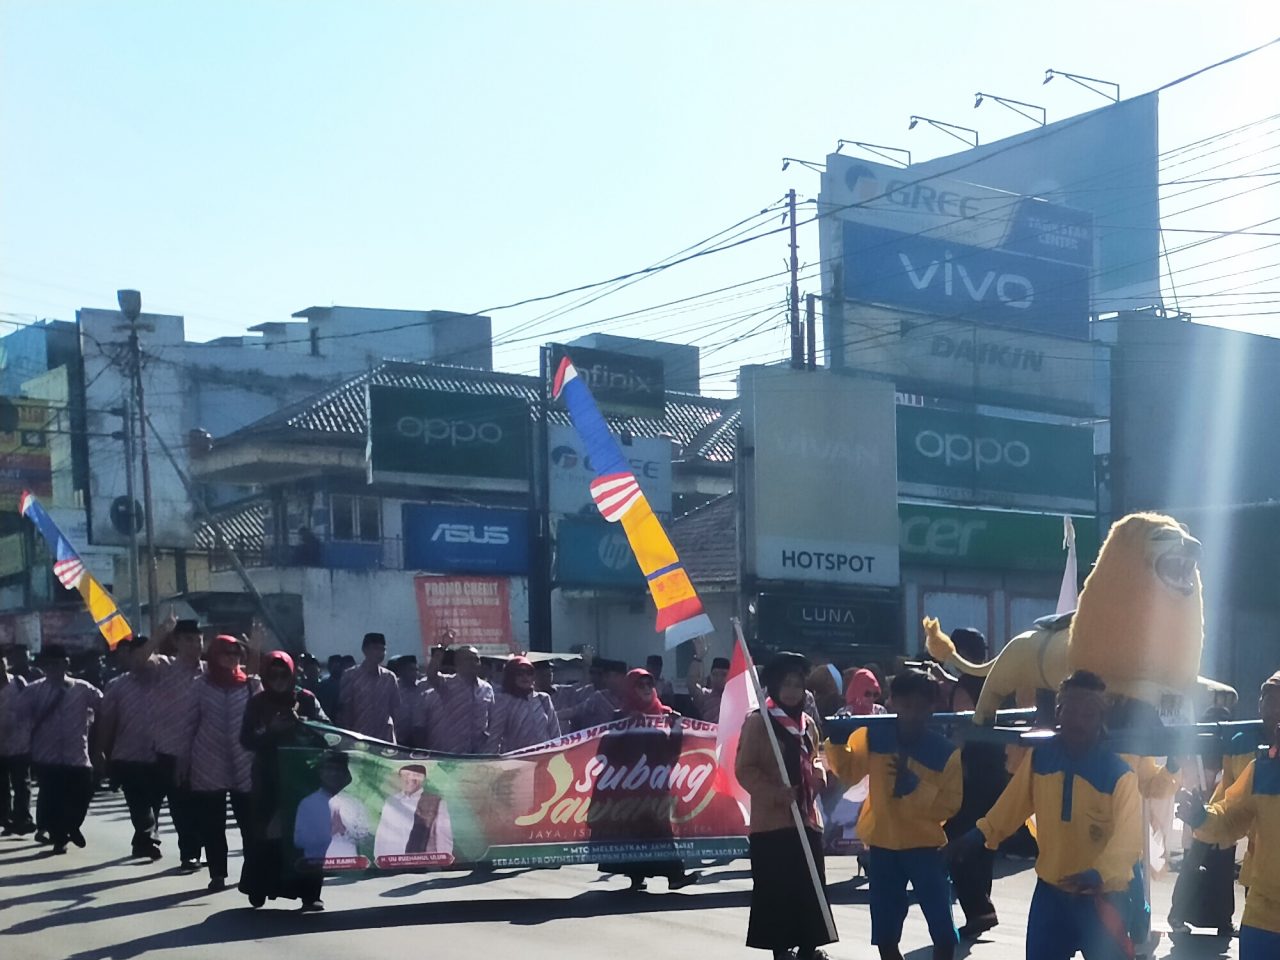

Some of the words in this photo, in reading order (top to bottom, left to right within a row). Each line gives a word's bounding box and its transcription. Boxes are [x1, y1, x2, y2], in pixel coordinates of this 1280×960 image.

[886, 180, 979, 218] GREE
[899, 249, 1034, 309] vivo
[930, 334, 1044, 371] DAIKIN
[575, 364, 652, 392] nfinix
[397, 416, 502, 447] oppo
[915, 430, 1030, 471] oppo
[431, 523, 509, 545] ASUS
[900, 515, 987, 557] cer
[782, 549, 876, 574] HOTSPOT
[424, 582, 462, 596] PROMO
[802, 607, 856, 624] LUNA
[575, 752, 714, 803] Subang
[492, 857, 530, 867] SEBAGAI
